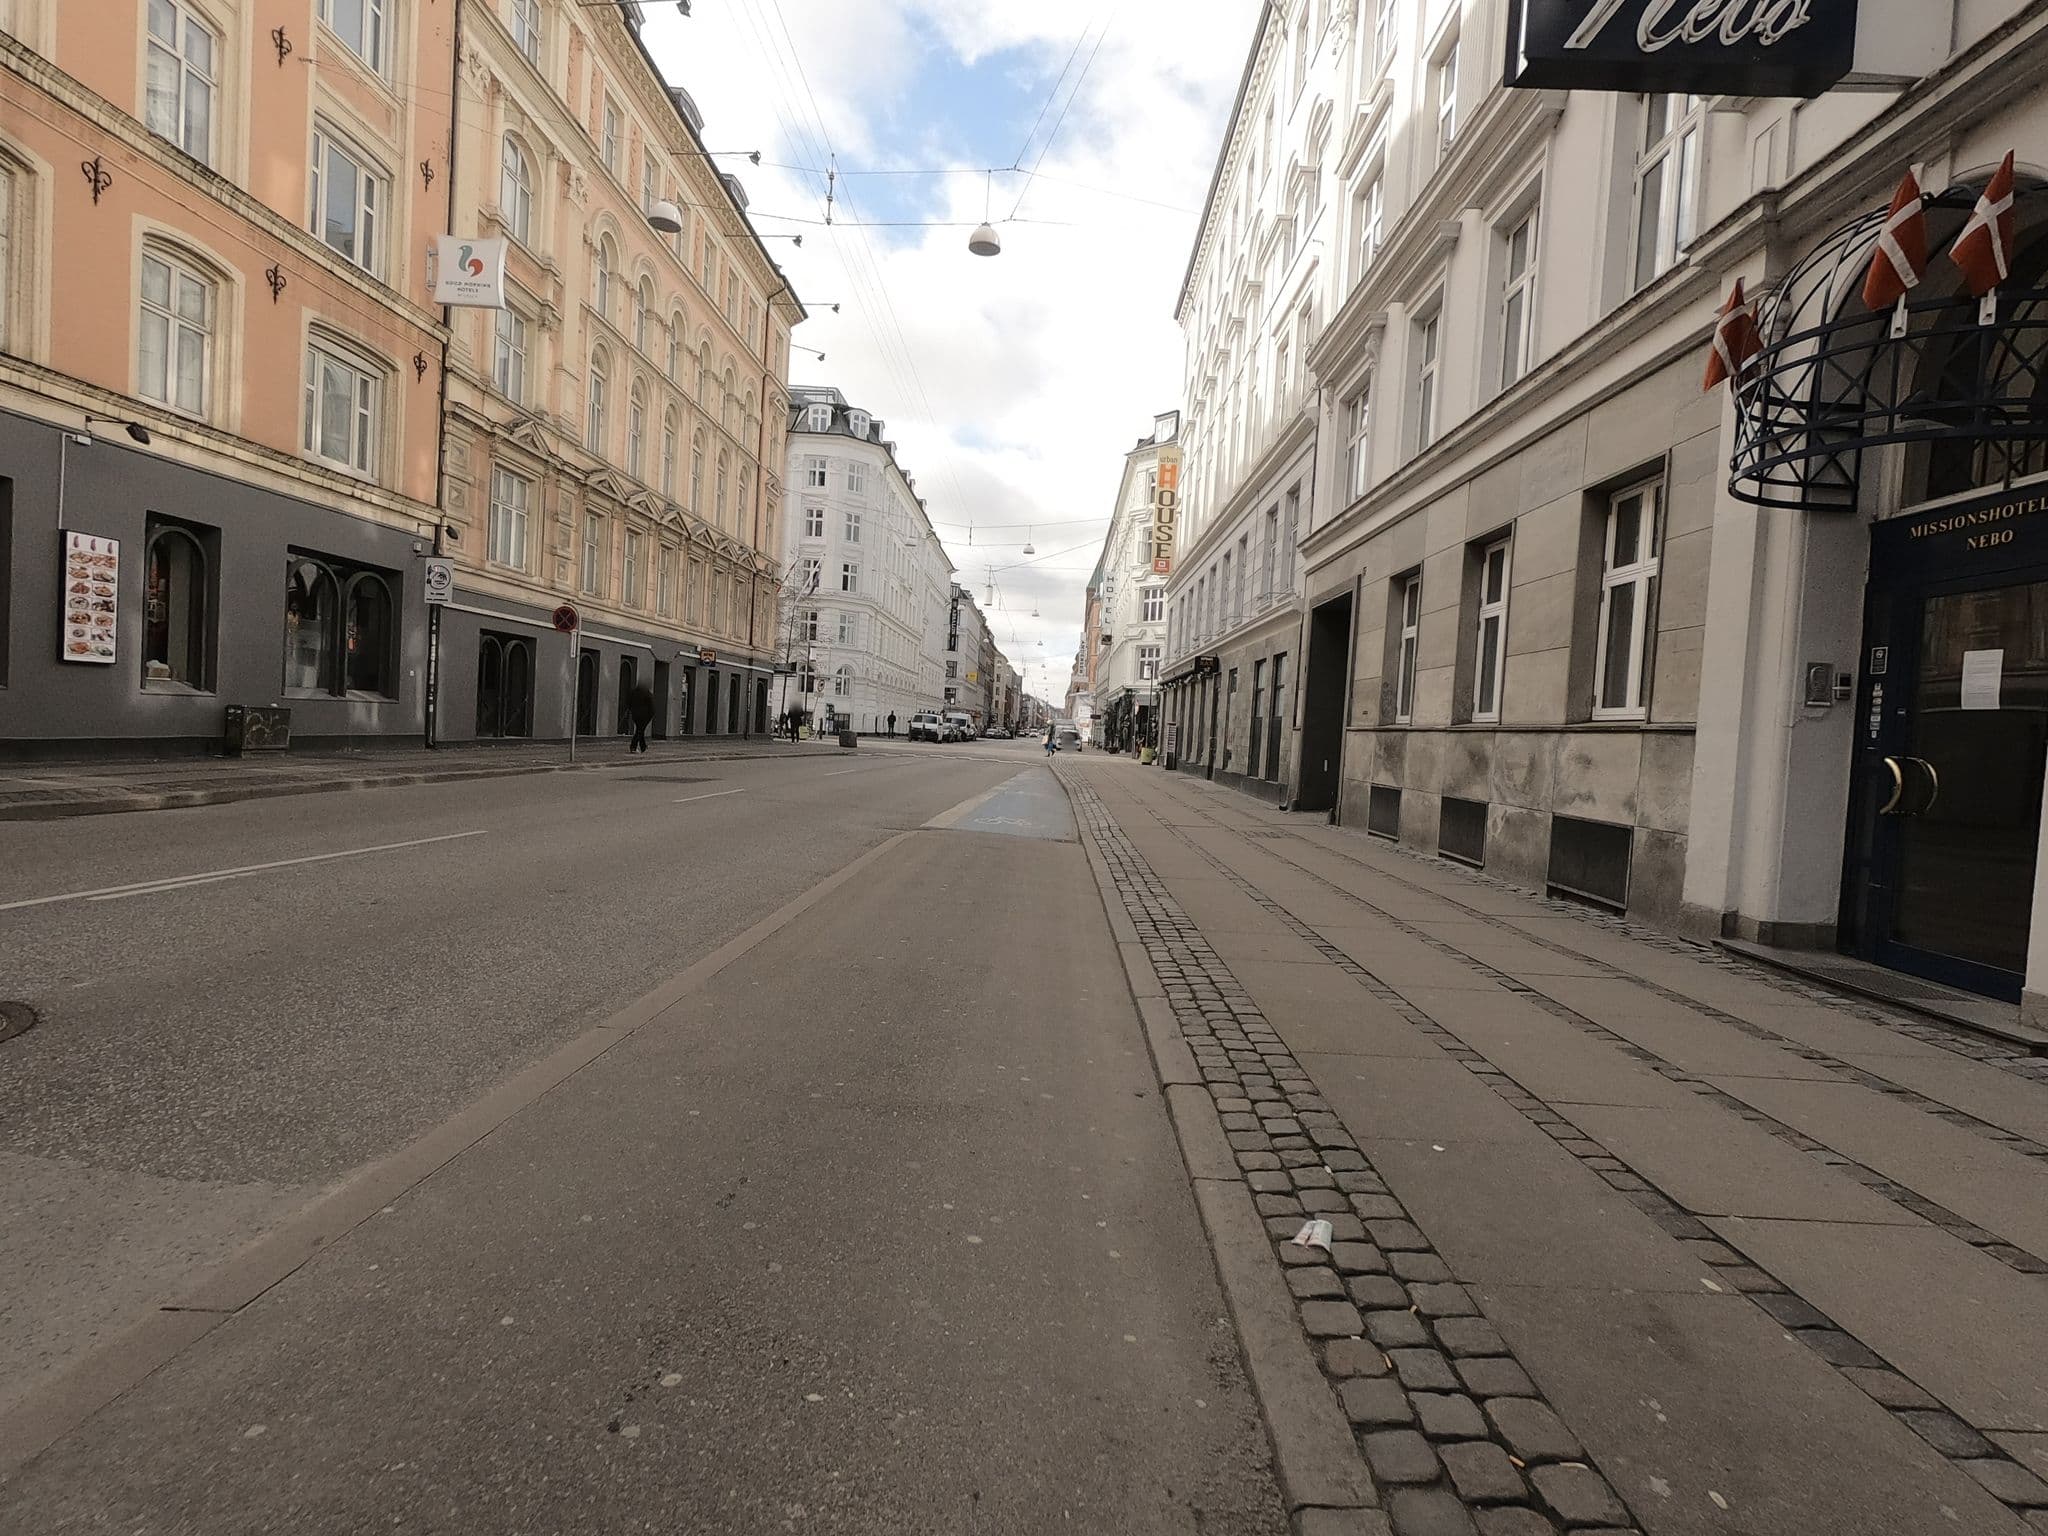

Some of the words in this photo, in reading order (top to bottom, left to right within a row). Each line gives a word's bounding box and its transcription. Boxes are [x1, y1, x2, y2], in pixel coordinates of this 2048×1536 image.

[1155, 464, 1177, 559] HOUSE
[1910, 497, 2048, 538] MISSIONSHOTEL
[1966, 529, 2014, 550] NEBO
[1105, 576, 1114, 624] HOTEL
